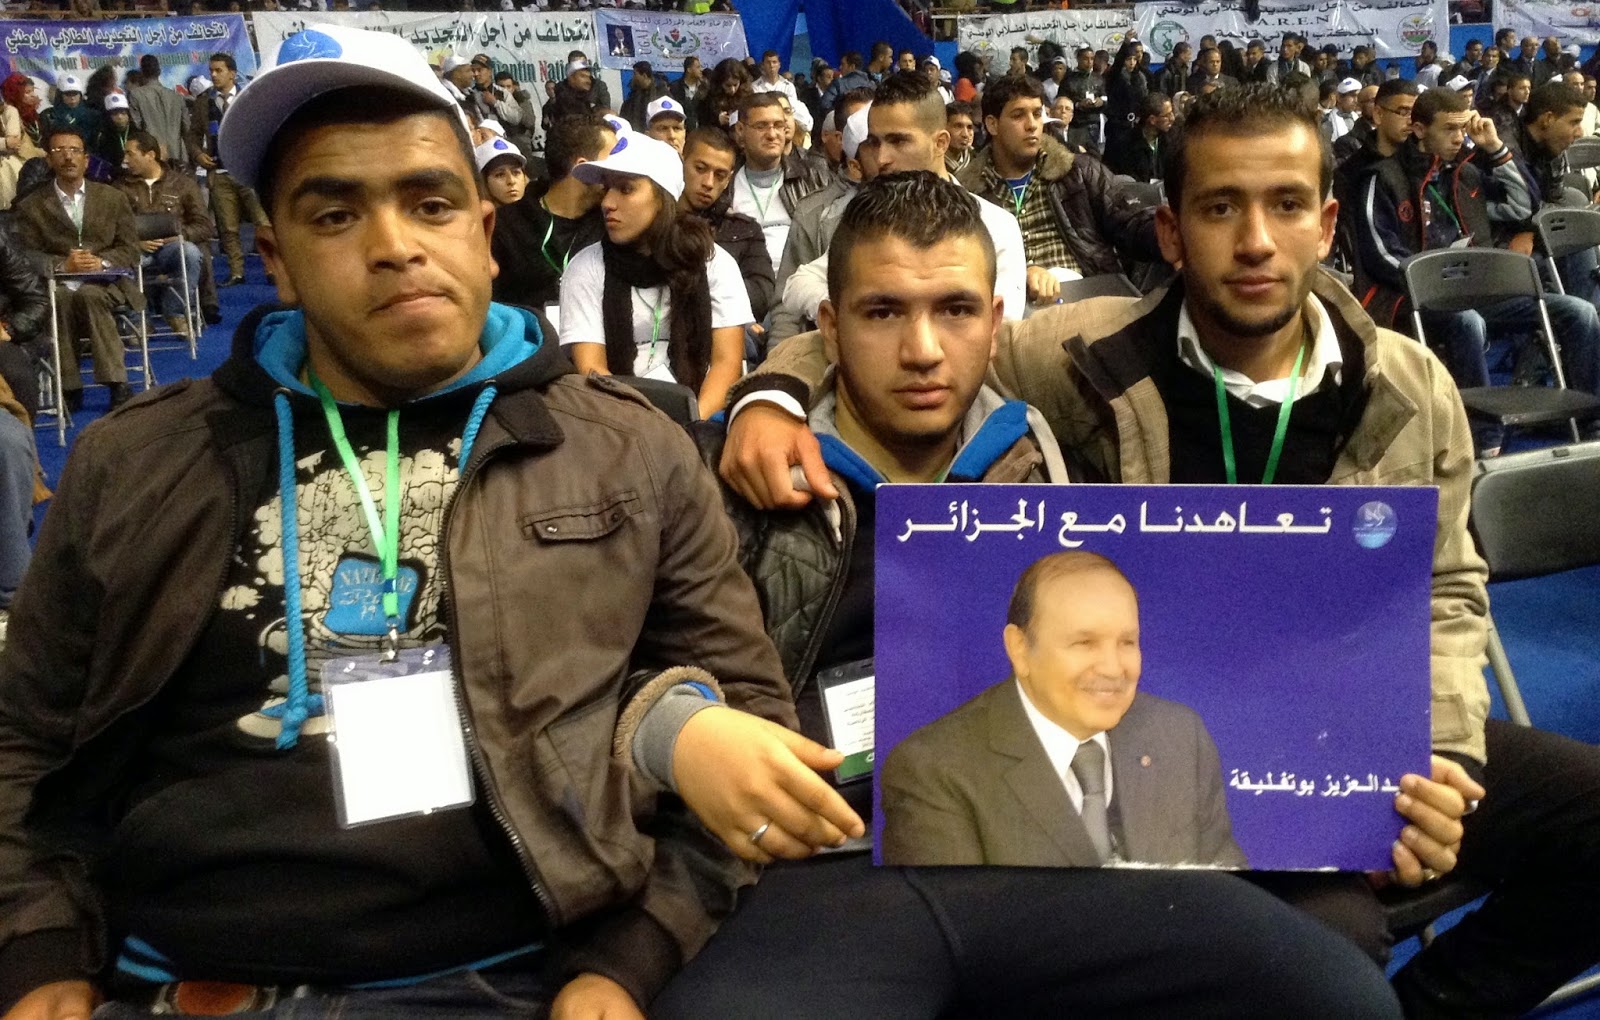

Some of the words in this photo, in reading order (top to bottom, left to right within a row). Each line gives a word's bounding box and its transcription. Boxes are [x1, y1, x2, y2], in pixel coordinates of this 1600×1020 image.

[1156, 6, 1199, 18] الوطني
[1352, 2, 1372, 11] من
[96, 24, 143, 49] التجديد
[168, 25, 184, 46] من
[184, 20, 230, 41] التحالف
[410, 19, 474, 51] التجديد
[513, 22, 532, 48] من
[535, 18, 596, 43] التحالف
[1082, 20, 1093, 32] من
[6, 27, 48, 53] الوطني
[49, 27, 95, 51] الطلابي
[896, 497, 1046, 542] الجزائر
[1057, 510, 1127, 548] مع
[1139, 500, 1332, 533] تعاهدنا
[1229, 767, 1316, 797] بوتفليقة
[1320, 772, 1380, 798] العزيز
